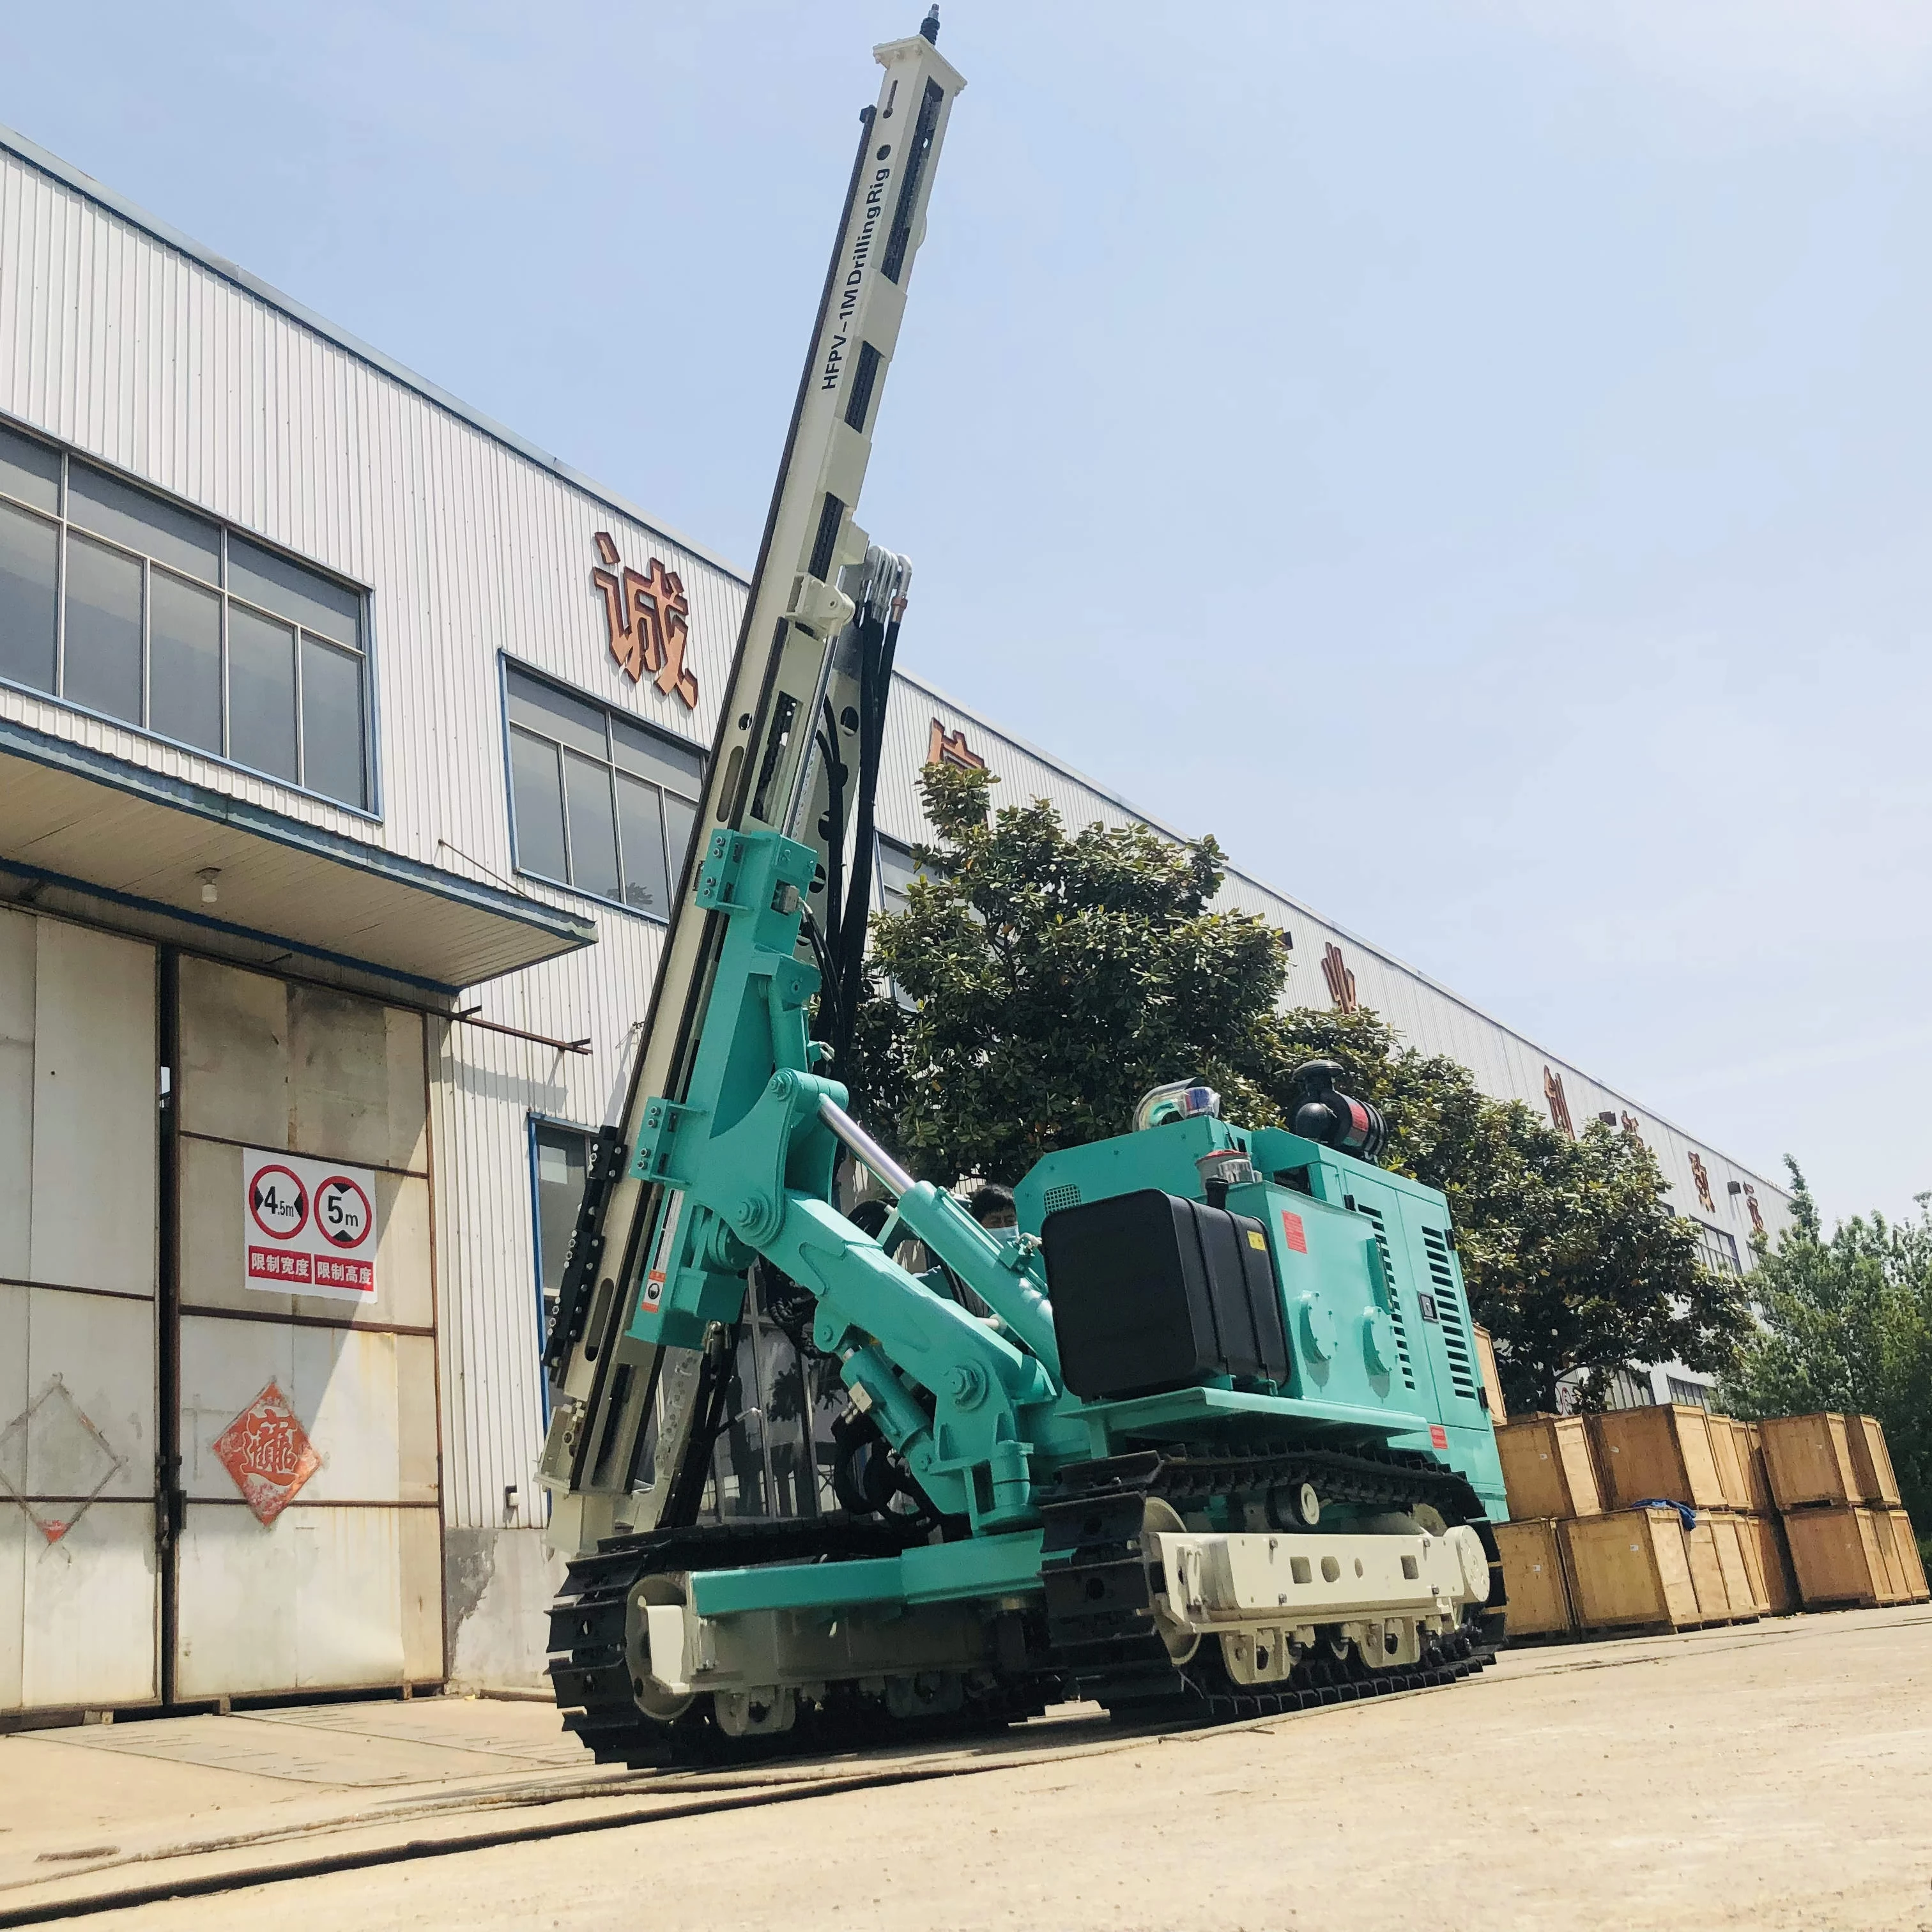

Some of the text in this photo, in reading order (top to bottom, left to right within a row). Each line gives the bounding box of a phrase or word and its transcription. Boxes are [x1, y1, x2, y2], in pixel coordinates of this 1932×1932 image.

[822, 288, 859, 390] HFPV-1M
[593, 532, 698, 710] 诚
[328, 1195, 358, 1227] 5m
[251, 1252, 309, 1276] 限制宽度
[317, 1261, 372, 1284] 限制高度
